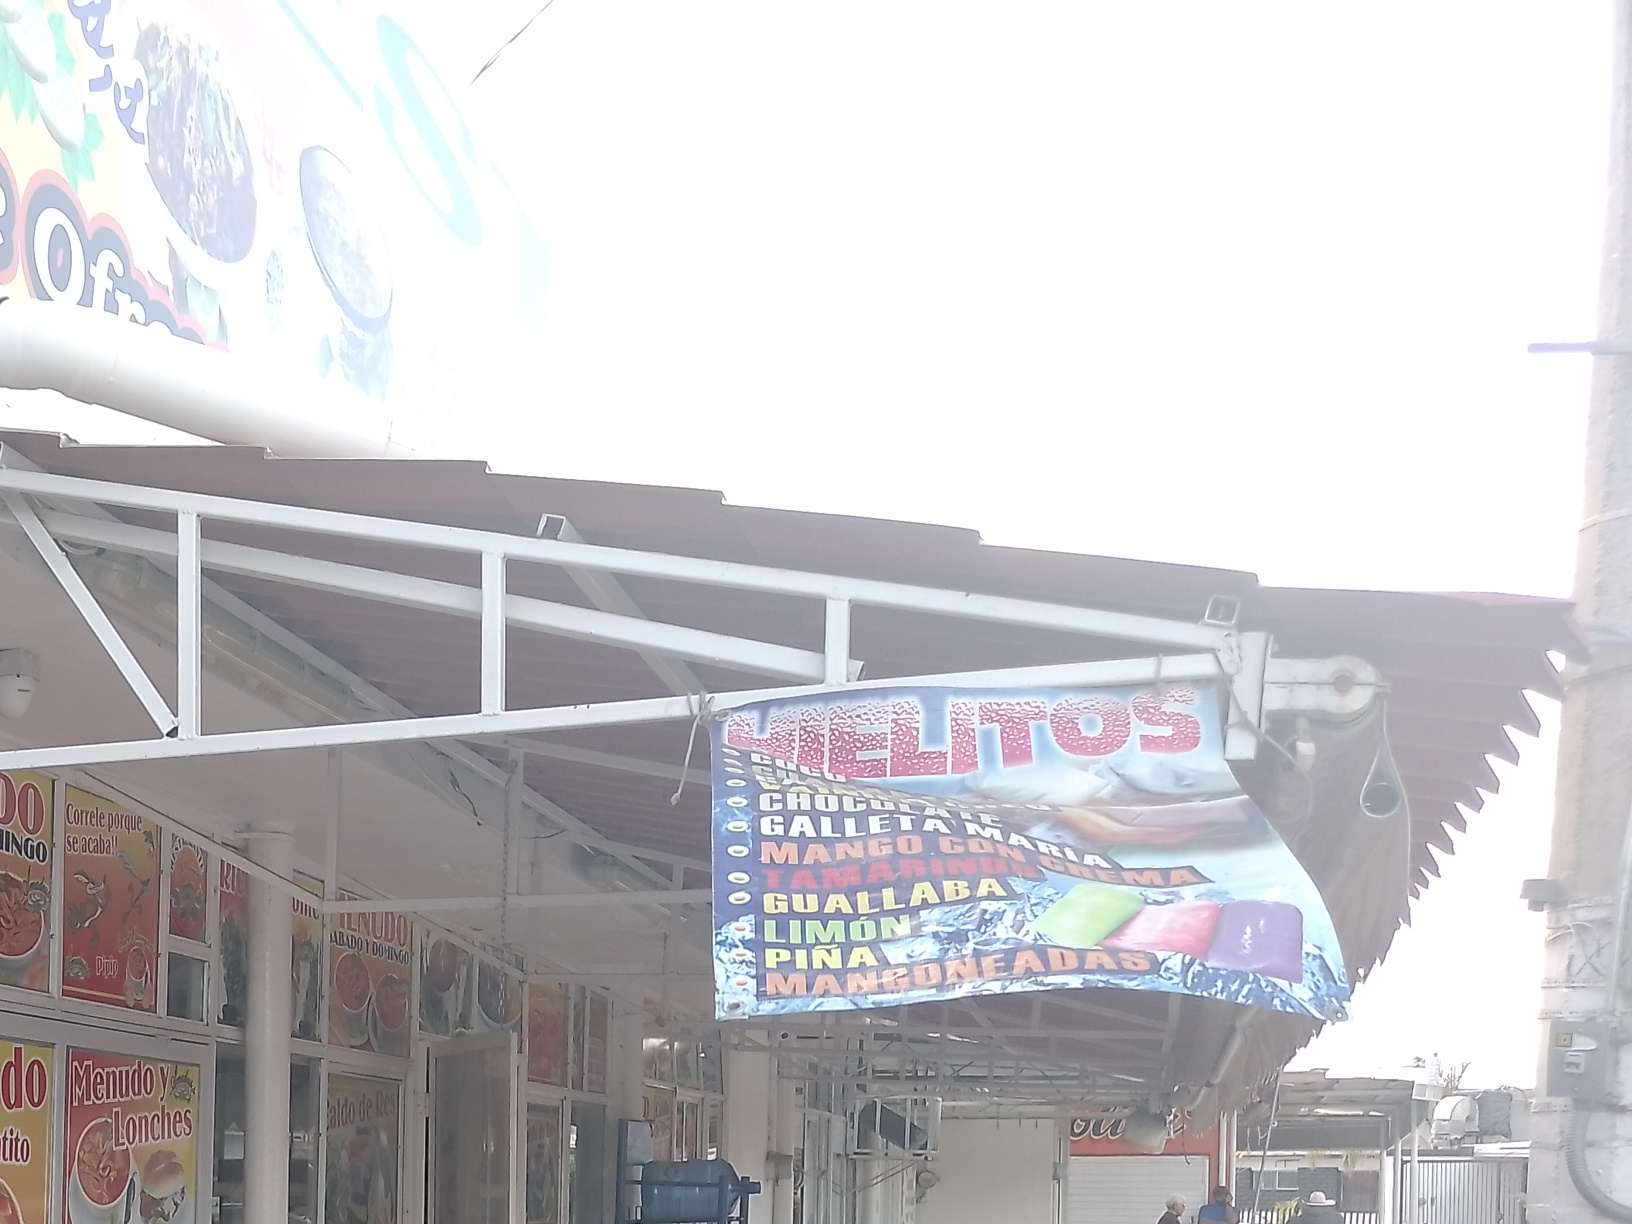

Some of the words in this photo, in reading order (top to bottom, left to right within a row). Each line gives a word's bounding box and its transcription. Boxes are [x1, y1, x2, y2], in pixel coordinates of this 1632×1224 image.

[33, 206, 176, 336] Ofr
[66, 802, 106, 829] Correle
[107, 812, 143, 835] porque
[759, 814, 953, 838] GALLETA
[66, 834, 79, 853] se
[761, 835, 923, 865] MANGO
[938, 835, 1027, 864] CON
[1038, 855, 1201, 887] CREMA
[762, 878, 1008, 915] GUALLABA
[329, 930, 363, 953] ABADO
[763, 914, 913, 944] LIMÓN
[764, 944, 879, 970] PIÑA
[765, 946, 1154, 997] MANGONEADAS
[71, 1060, 155, 1106] Menudo
[111, 1106, 194, 1150] Lonches
[327, 1096, 356, 1130] aldo
